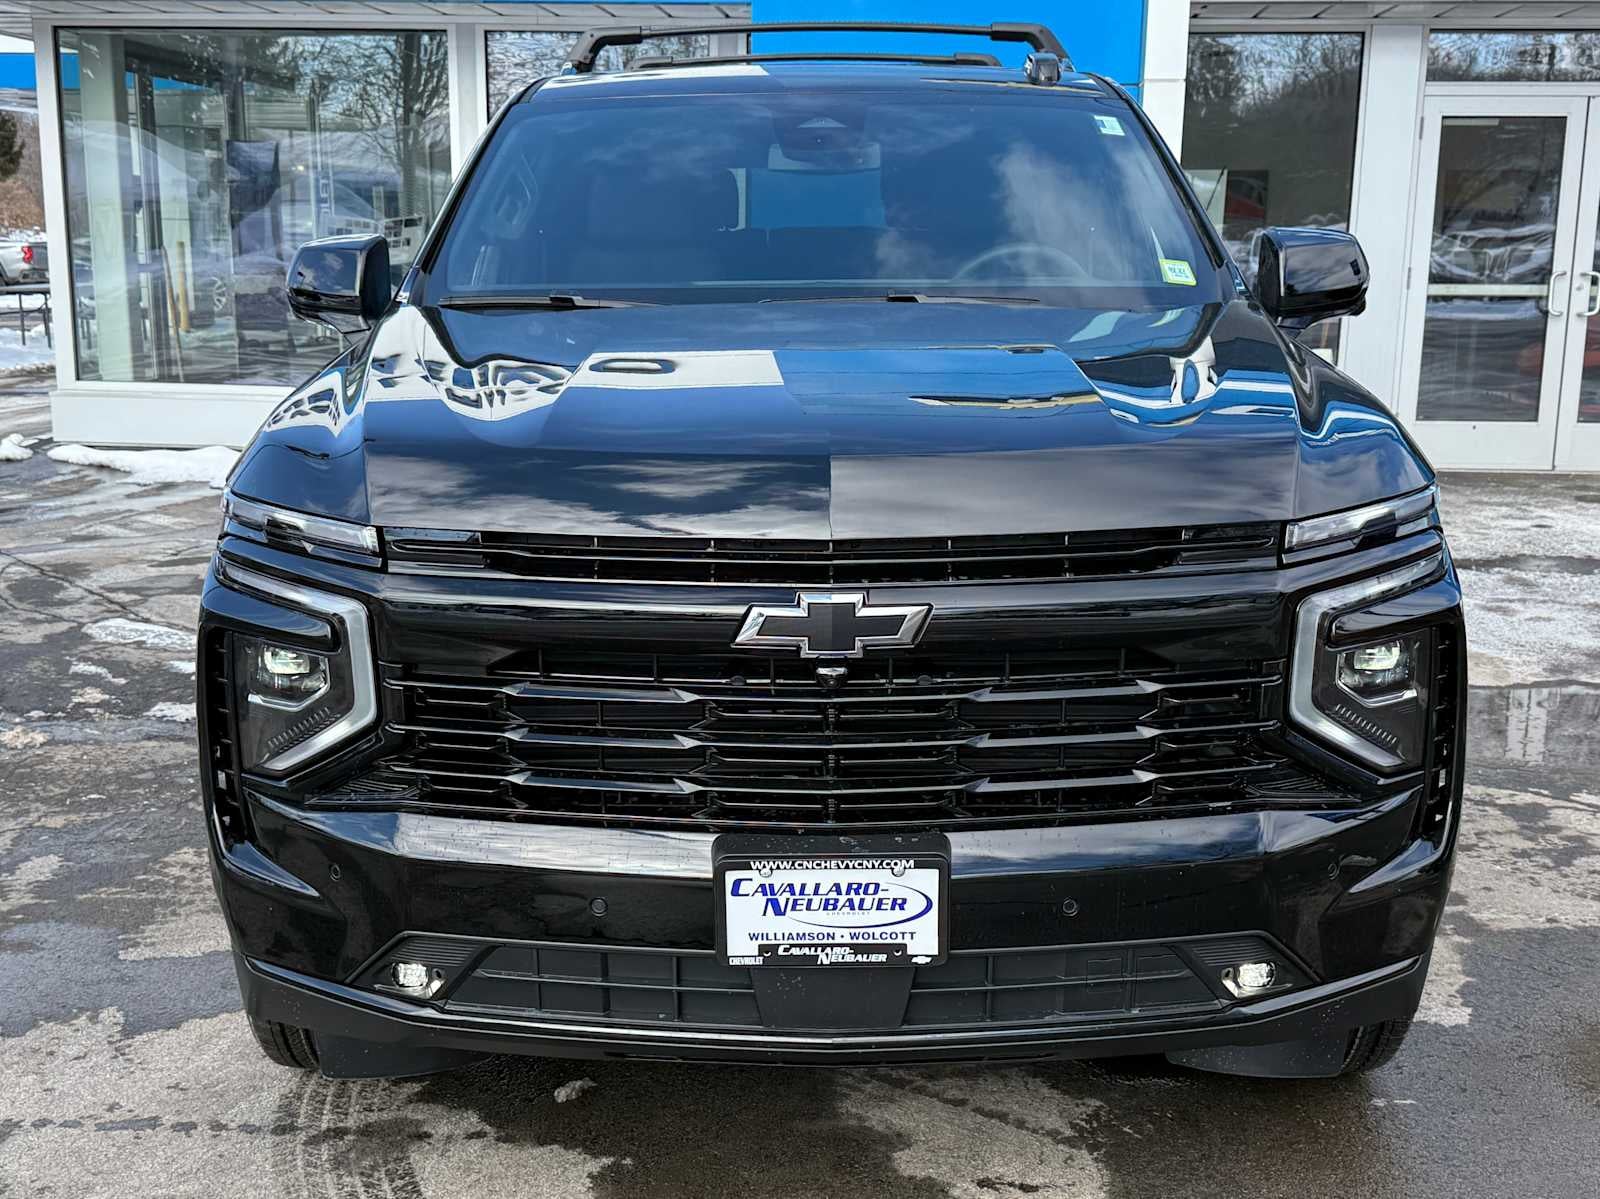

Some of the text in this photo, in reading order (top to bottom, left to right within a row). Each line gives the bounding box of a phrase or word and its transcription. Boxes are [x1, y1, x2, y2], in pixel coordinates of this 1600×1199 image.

[750, 859, 914, 870] WWW.CNCHEVYCNY.COM
[762, 897, 907, 917] NEUBAUER
[748, 931, 916, 941] WILLIAMSON WOLCOTT
[729, 956, 764, 966] CHEVROLET
[817, 951, 887, 965] NEUBAUER
